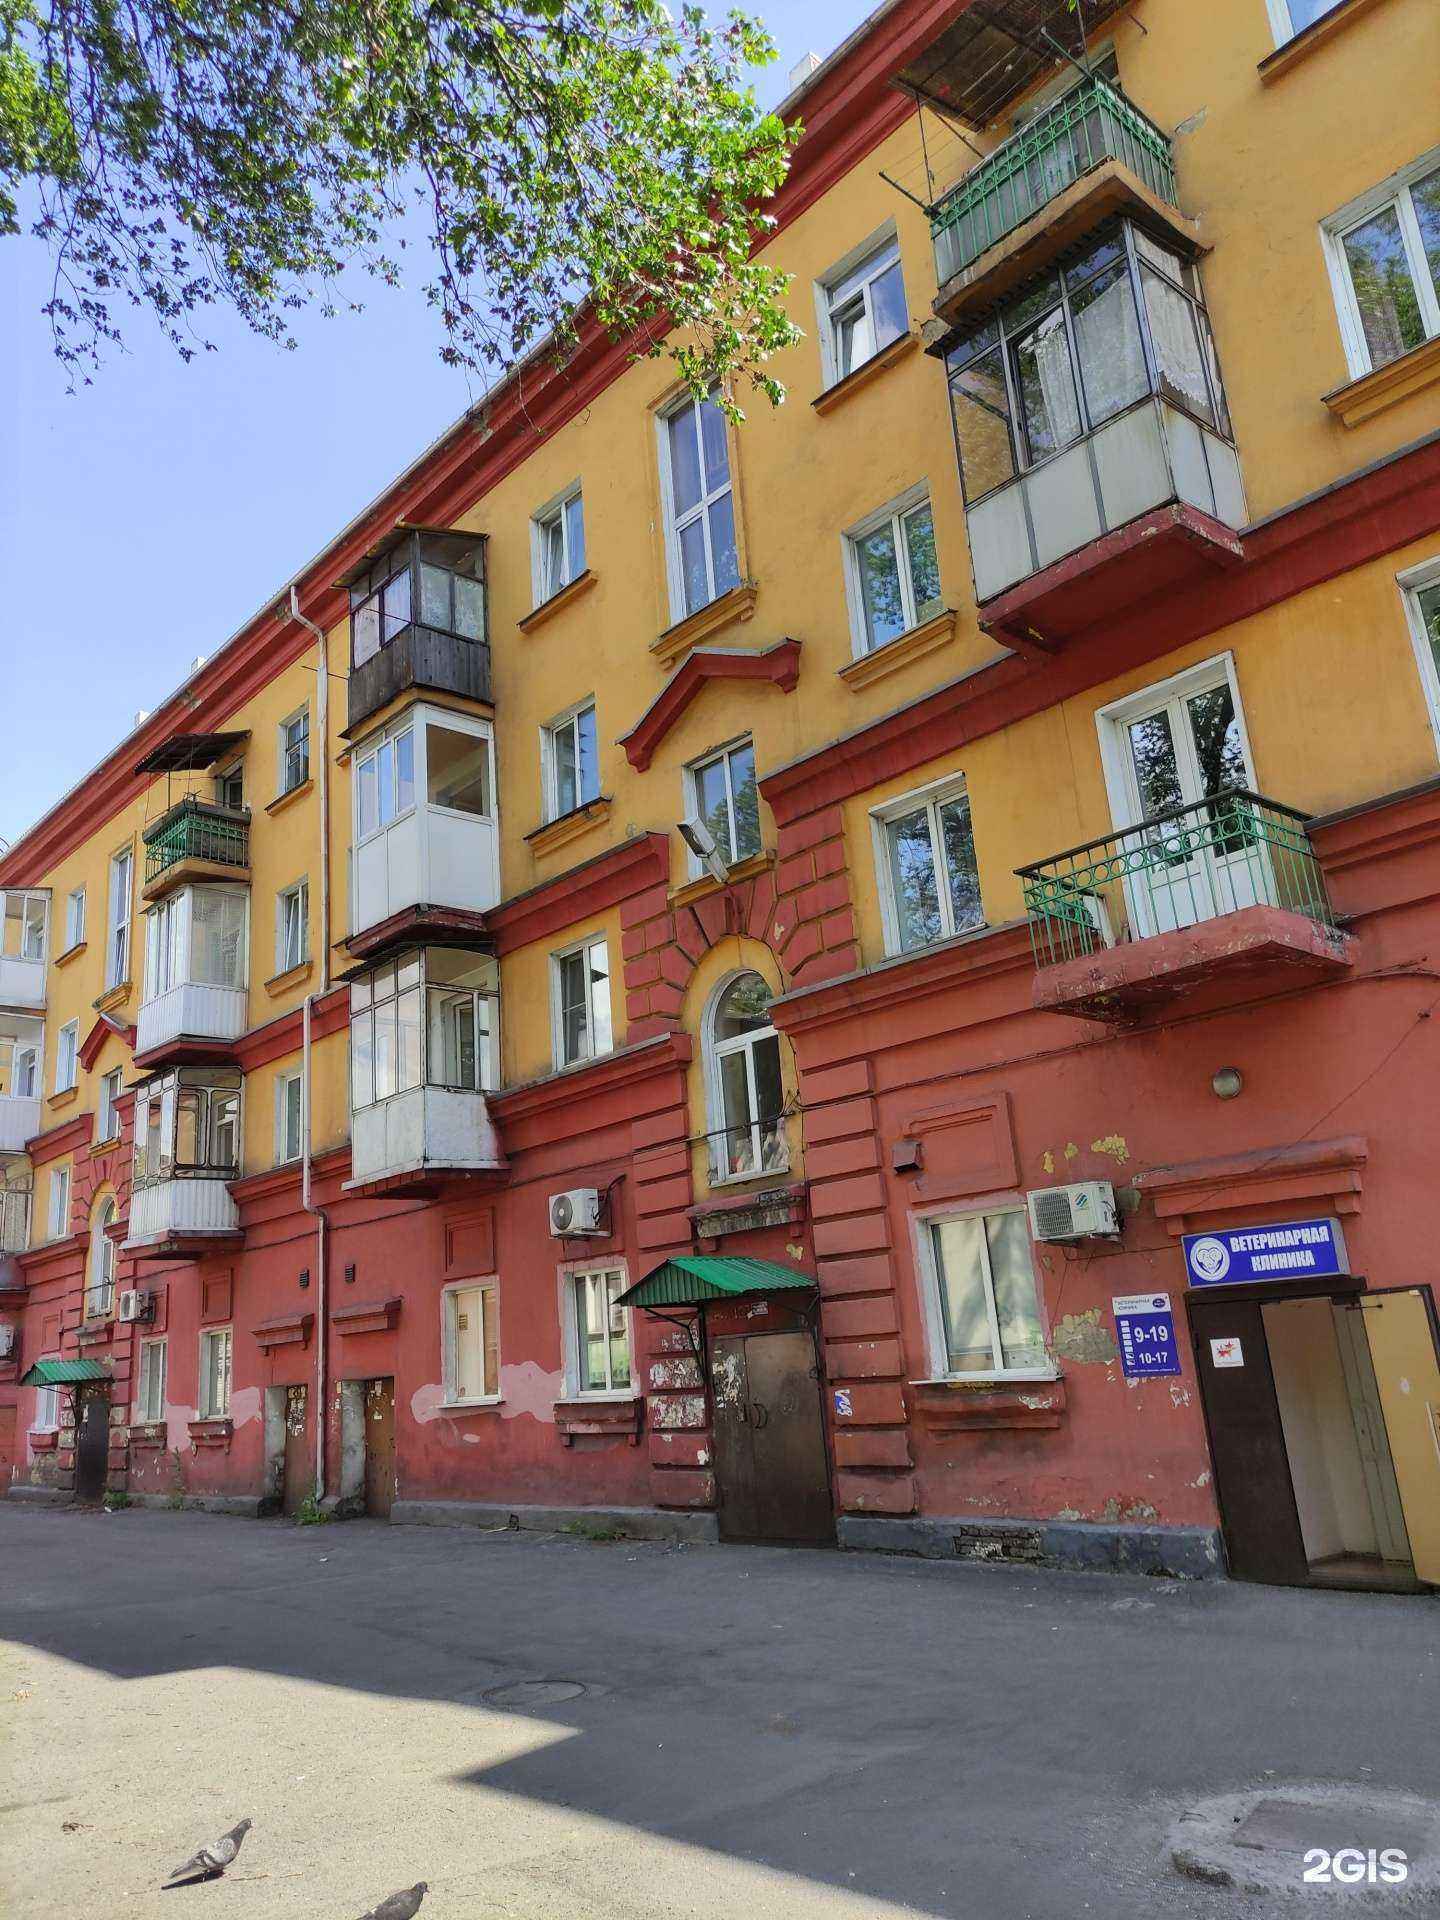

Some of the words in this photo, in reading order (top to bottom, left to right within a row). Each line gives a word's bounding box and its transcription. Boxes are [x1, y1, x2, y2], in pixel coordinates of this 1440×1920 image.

[1229, 1225, 1330, 1253] ВЕТЕРИНАРНАЯ
[1251, 1250, 1316, 1272] КЛИНИКА
[1133, 1325, 1169, 1343] 9-19
[1138, 1351, 1168, 1364] 10-17
